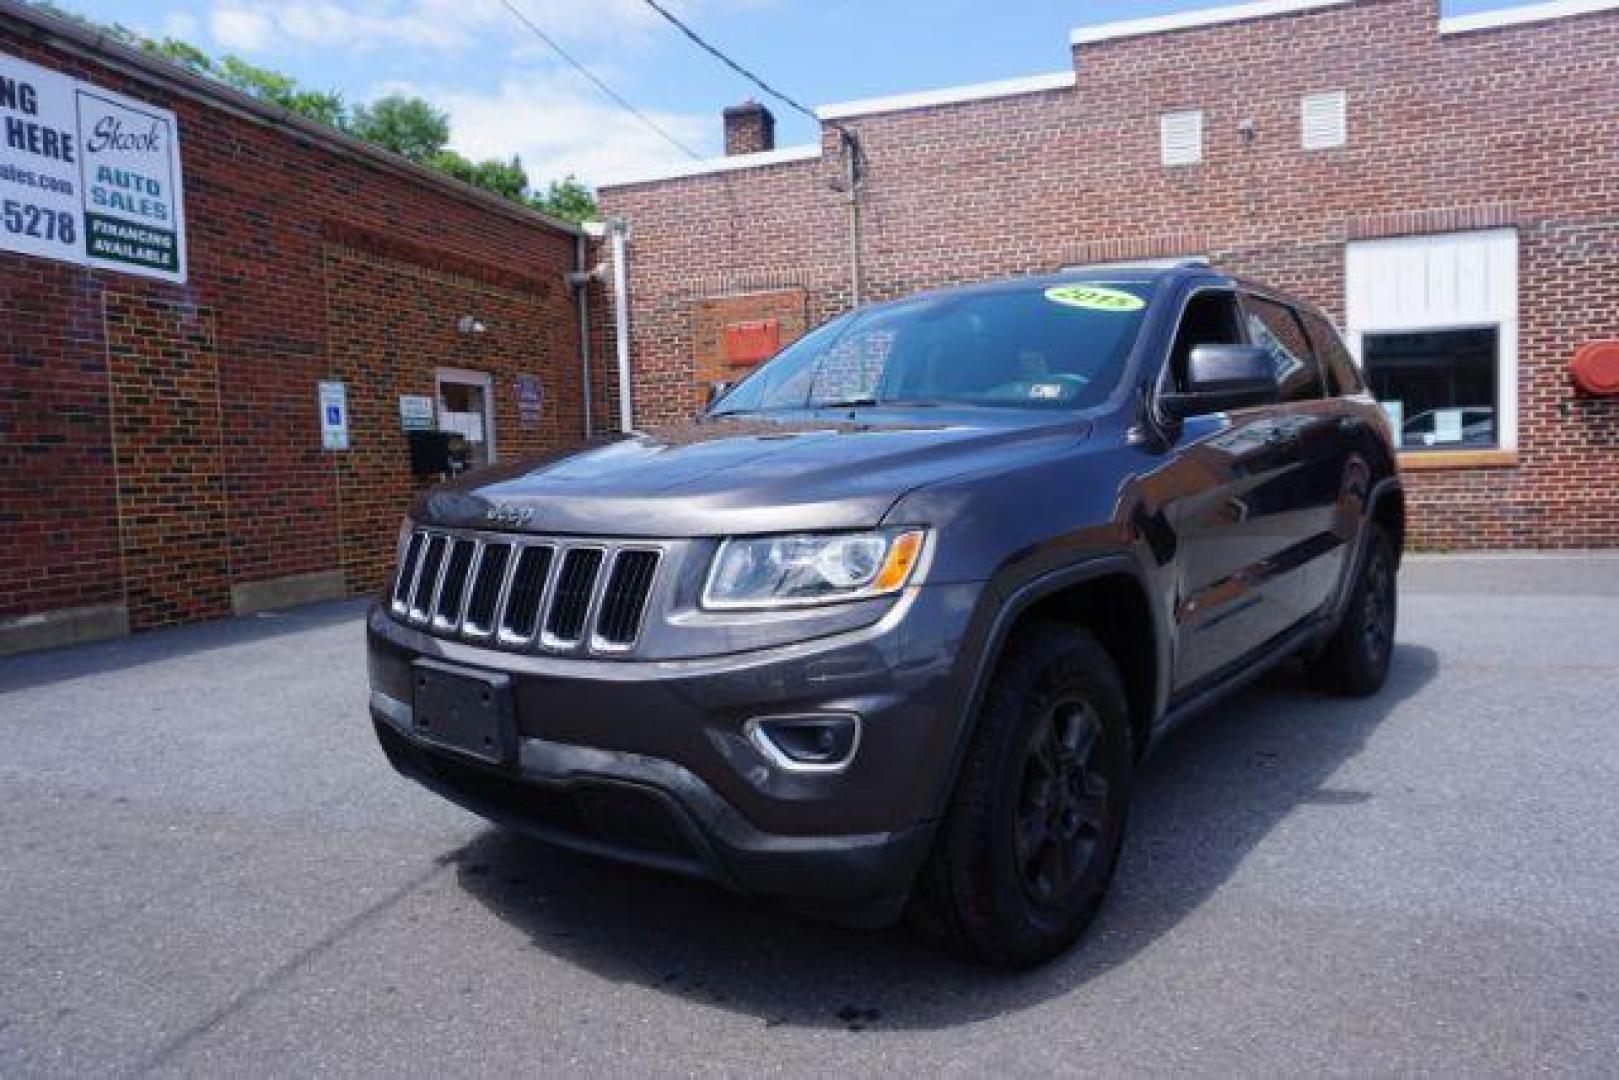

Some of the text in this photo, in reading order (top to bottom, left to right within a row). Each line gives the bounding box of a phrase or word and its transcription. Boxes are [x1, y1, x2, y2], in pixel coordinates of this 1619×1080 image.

[6, 116, 74, 162] HERE
[88, 115, 160, 152] Skook
[97, 167, 160, 196] AUTO
[91, 186, 168, 220] SALES
